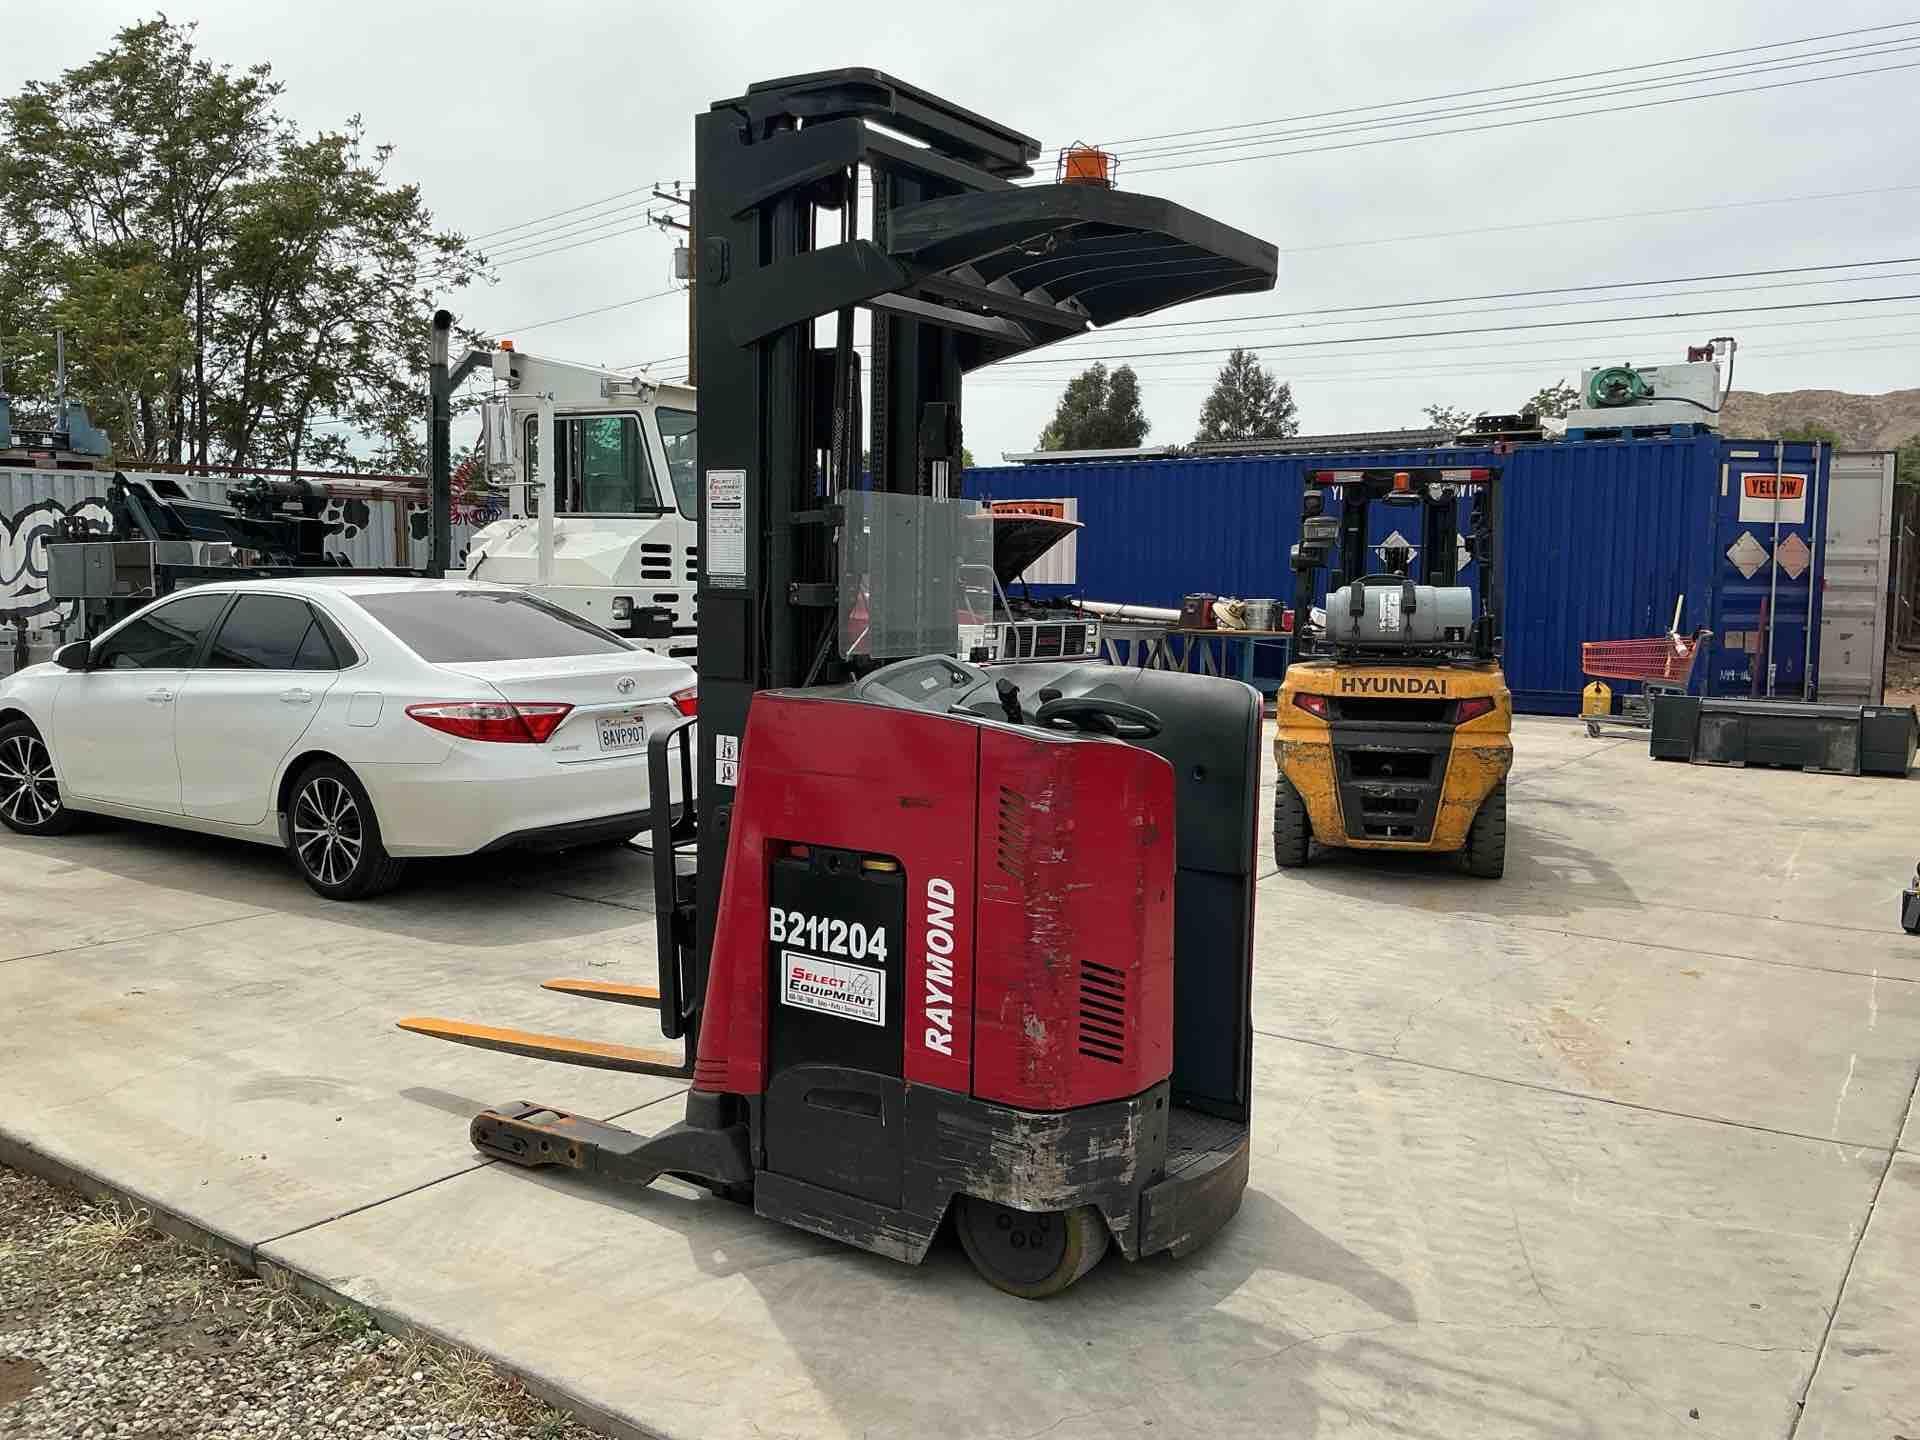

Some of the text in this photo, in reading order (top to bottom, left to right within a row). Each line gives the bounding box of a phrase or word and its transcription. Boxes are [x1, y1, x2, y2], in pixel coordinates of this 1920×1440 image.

[1341, 677, 1447, 695] HYUNDAI
[602, 726, 644, 746] 8AVP907
[769, 906, 888, 962] B211204
[791, 967, 847, 988] SELECT
[924, 877, 955, 1057] RAYMOND
[789, 979, 875, 1007] EQUIPMENT
